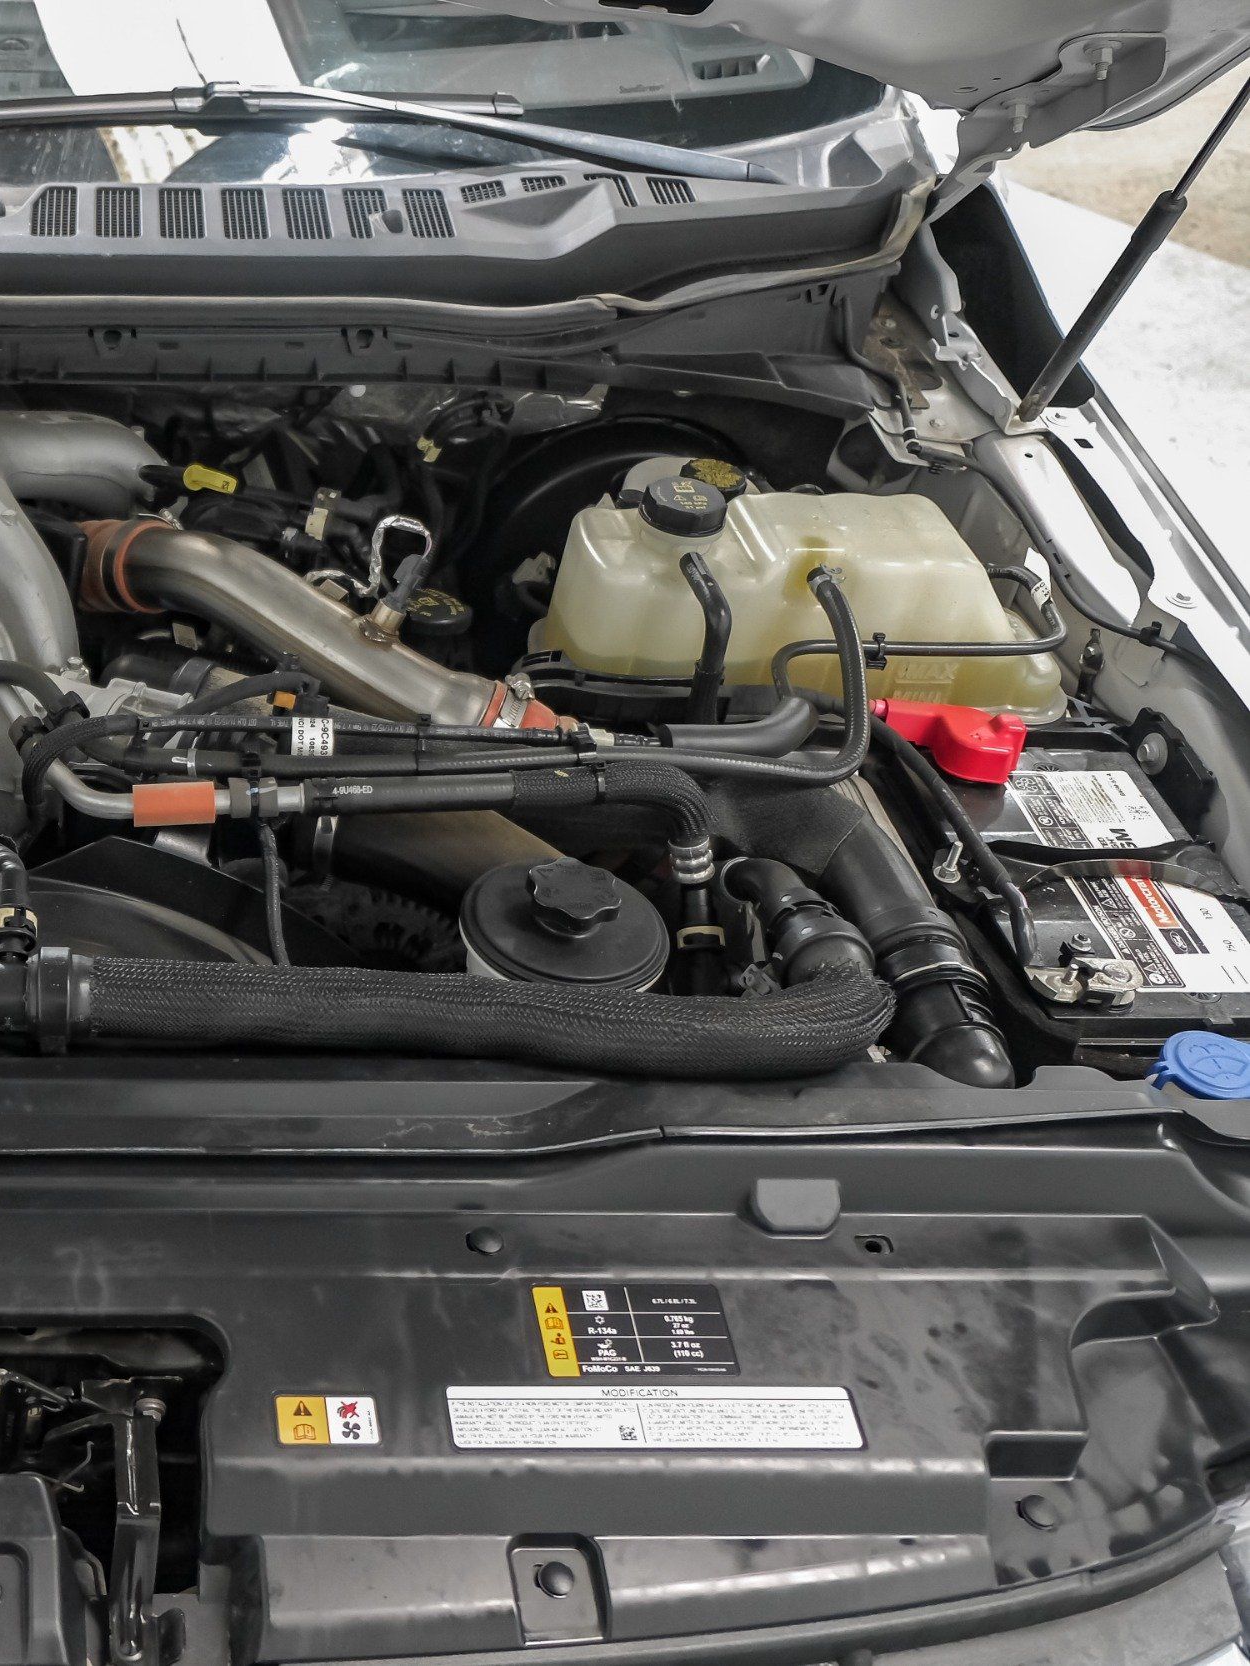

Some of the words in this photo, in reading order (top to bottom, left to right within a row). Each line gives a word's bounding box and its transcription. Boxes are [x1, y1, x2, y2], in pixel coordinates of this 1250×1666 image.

[297, 730, 305, 745] DOT
[1130, 878, 1173, 925] Motorcraf
[683, 1316, 695, 1324] kg
[587, 1327, 618, 1335] R-134a
[597, 1349, 617, 1357] PAG
[691, 1350, 705, 1358] cc)
[582, 1365, 619, 1373] FoMoCo
[624, 1365, 641, 1373] SAE
[601, 1389, 679, 1397] MODIFICATION
